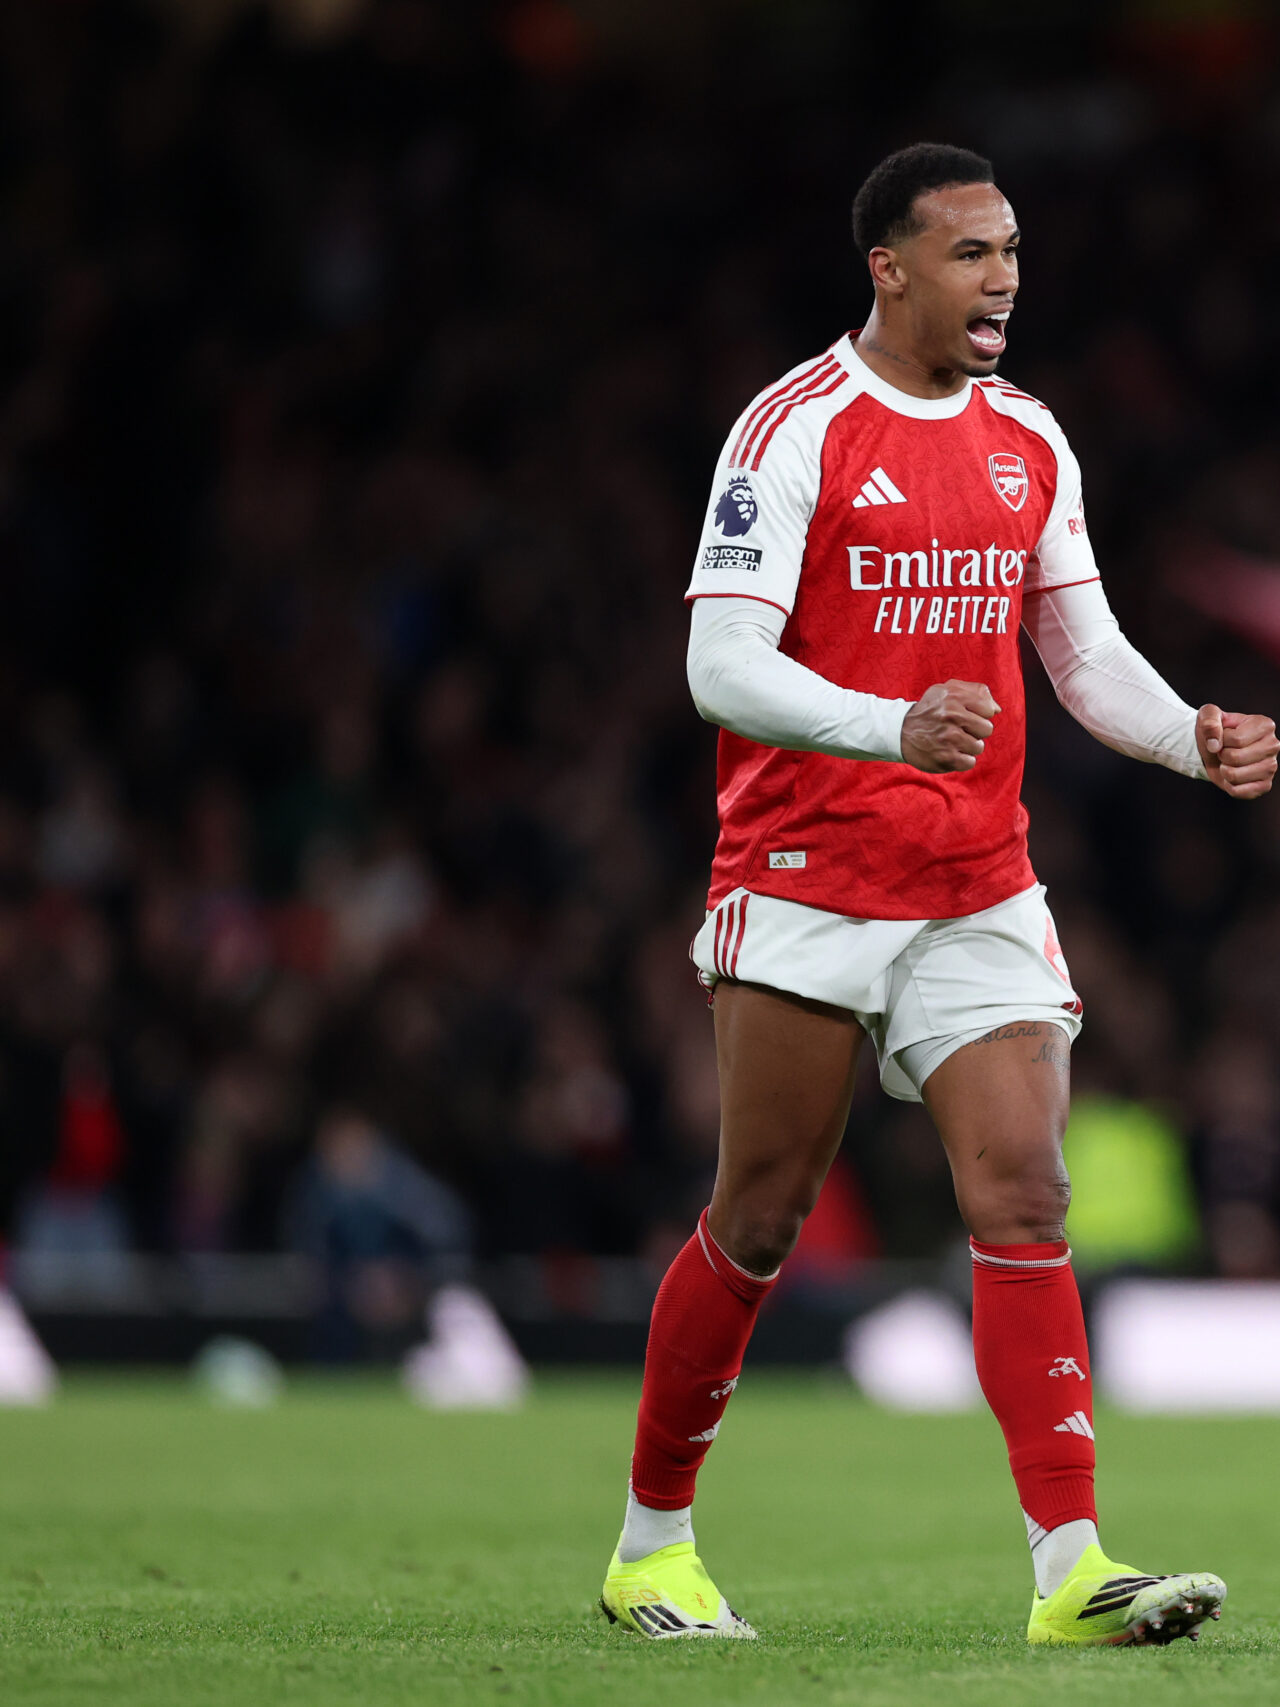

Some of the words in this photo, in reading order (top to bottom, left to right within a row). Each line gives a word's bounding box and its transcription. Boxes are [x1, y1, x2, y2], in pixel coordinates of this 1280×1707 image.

[703, 547, 719, 560] No
[720, 548, 756, 561] room
[717, 559, 760, 572] racism
[846, 538, 1027, 591] Emirates
[873, 597, 926, 634] FLY
[925, 596, 1010, 634] BETTER
